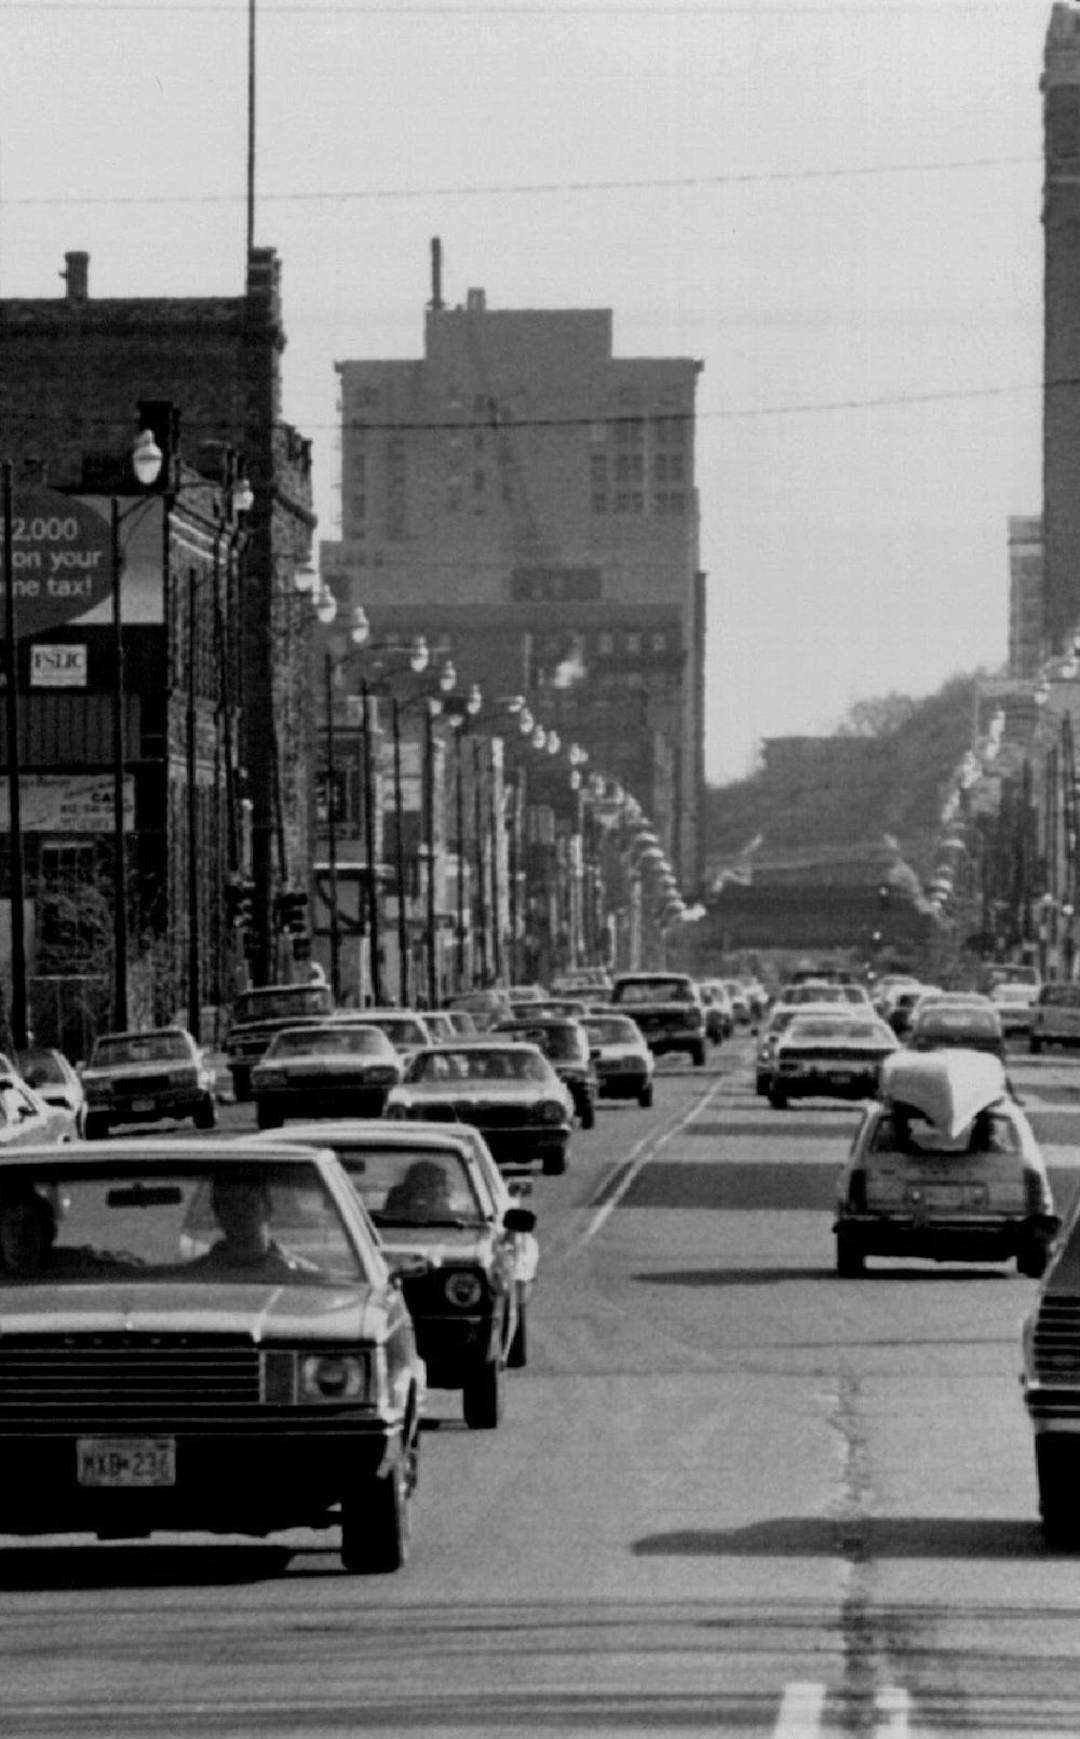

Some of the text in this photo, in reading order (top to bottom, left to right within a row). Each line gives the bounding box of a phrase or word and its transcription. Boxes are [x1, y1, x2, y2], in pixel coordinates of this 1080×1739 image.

[12, 551, 41, 569] on
[50, 550, 103, 572] your
[47, 575, 92, 597] tax!
